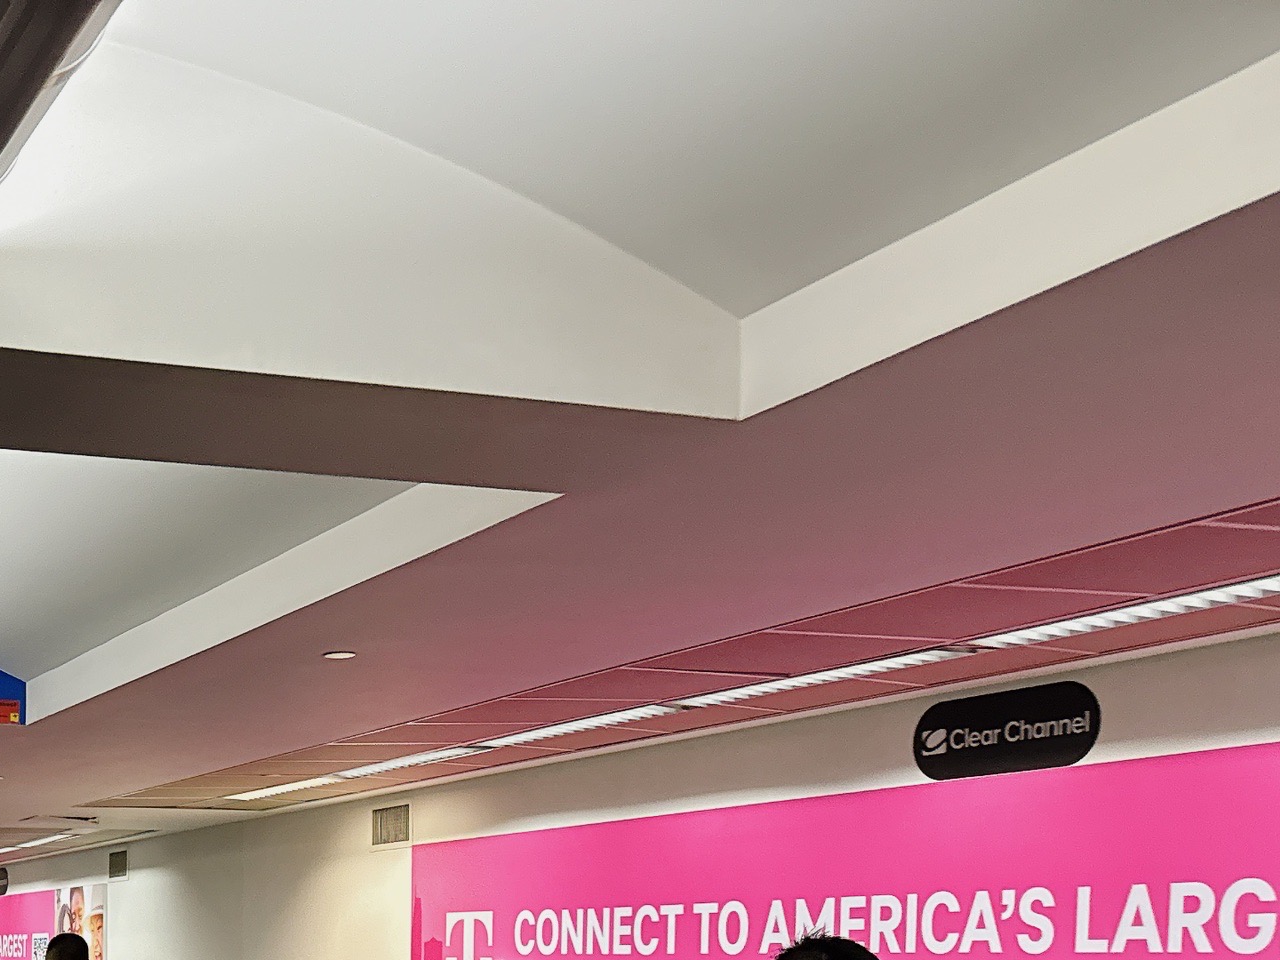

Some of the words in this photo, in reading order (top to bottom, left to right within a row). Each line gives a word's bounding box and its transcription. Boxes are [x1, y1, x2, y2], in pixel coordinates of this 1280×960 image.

[949, 727, 1002, 750] Clear
[1004, 710, 1091, 742] Channel
[514, 904, 685, 956] CONNECT
[693, 901, 749, 955] TO
